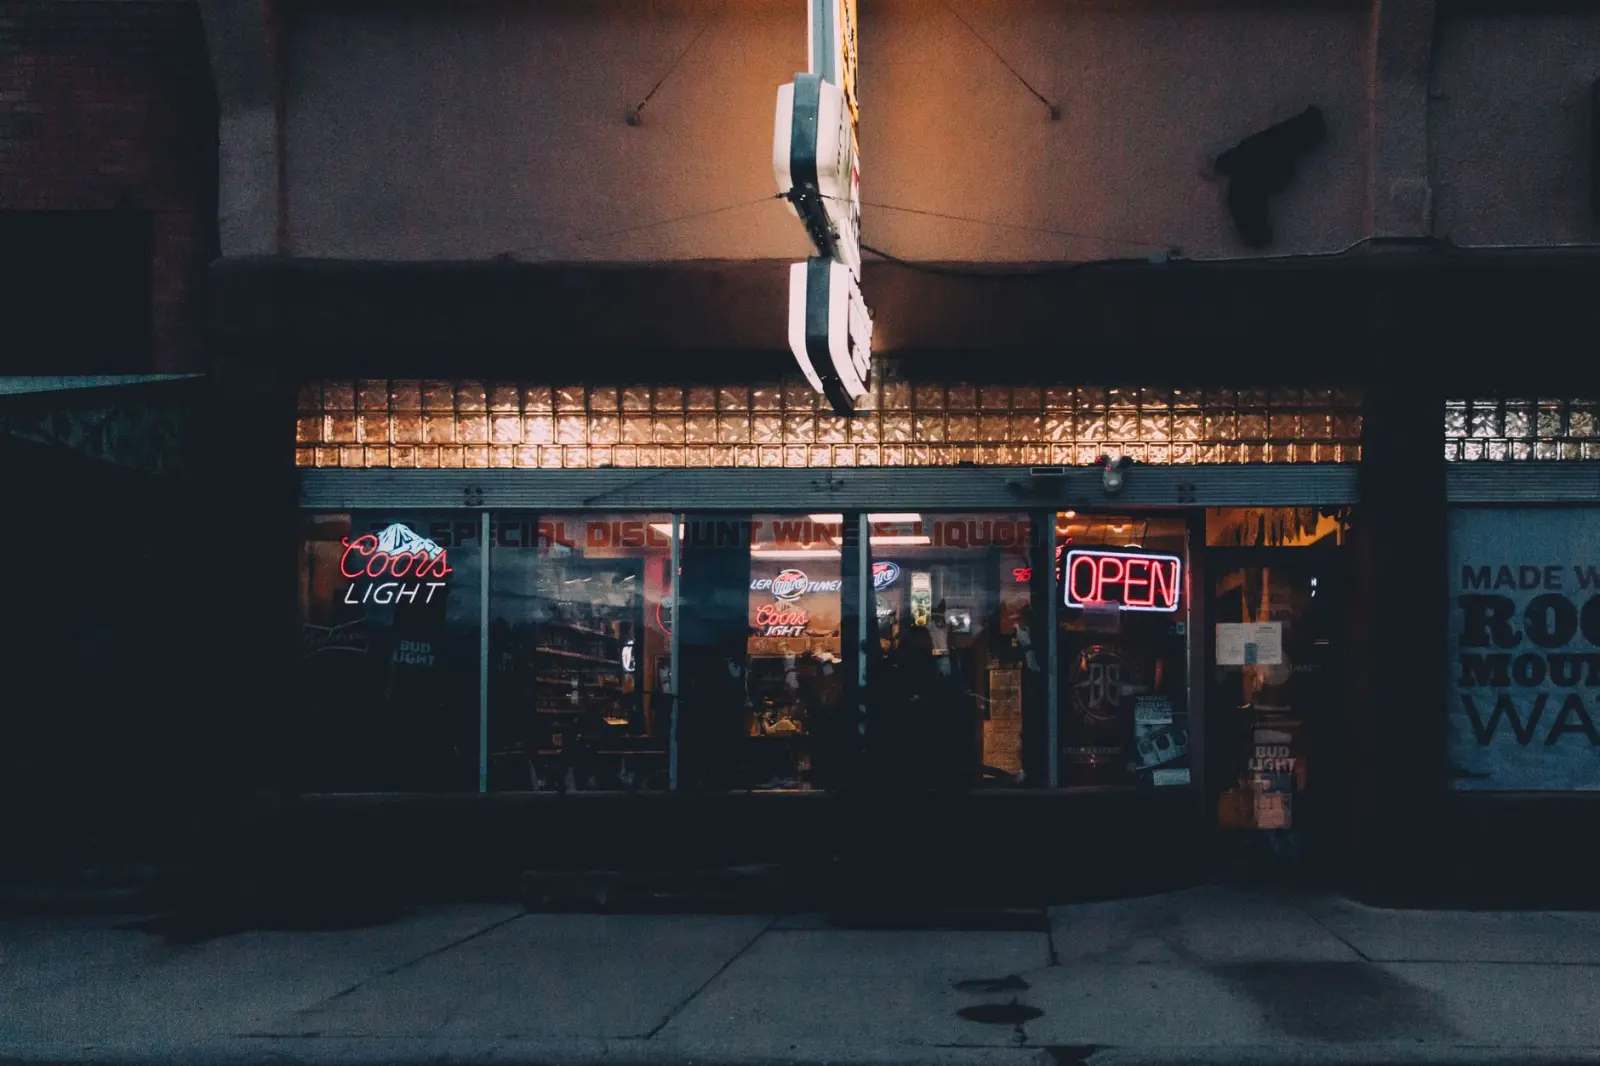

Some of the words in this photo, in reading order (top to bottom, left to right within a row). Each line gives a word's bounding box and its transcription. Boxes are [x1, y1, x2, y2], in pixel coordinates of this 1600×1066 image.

[340, 534, 454, 578] Coors
[1070, 555, 1178, 607] OPEN
[1461, 565, 1564, 590] MADE
[344, 582, 446, 604] LIGHT
[757, 604, 809, 626] Coors
[764, 625, 806, 637] IGHT
[400, 640, 431, 653] BUD
[392, 651, 436, 666] LIGHT
[1255, 745, 1290, 759] BUD
[1248, 757, 1296, 771] LIGHT
